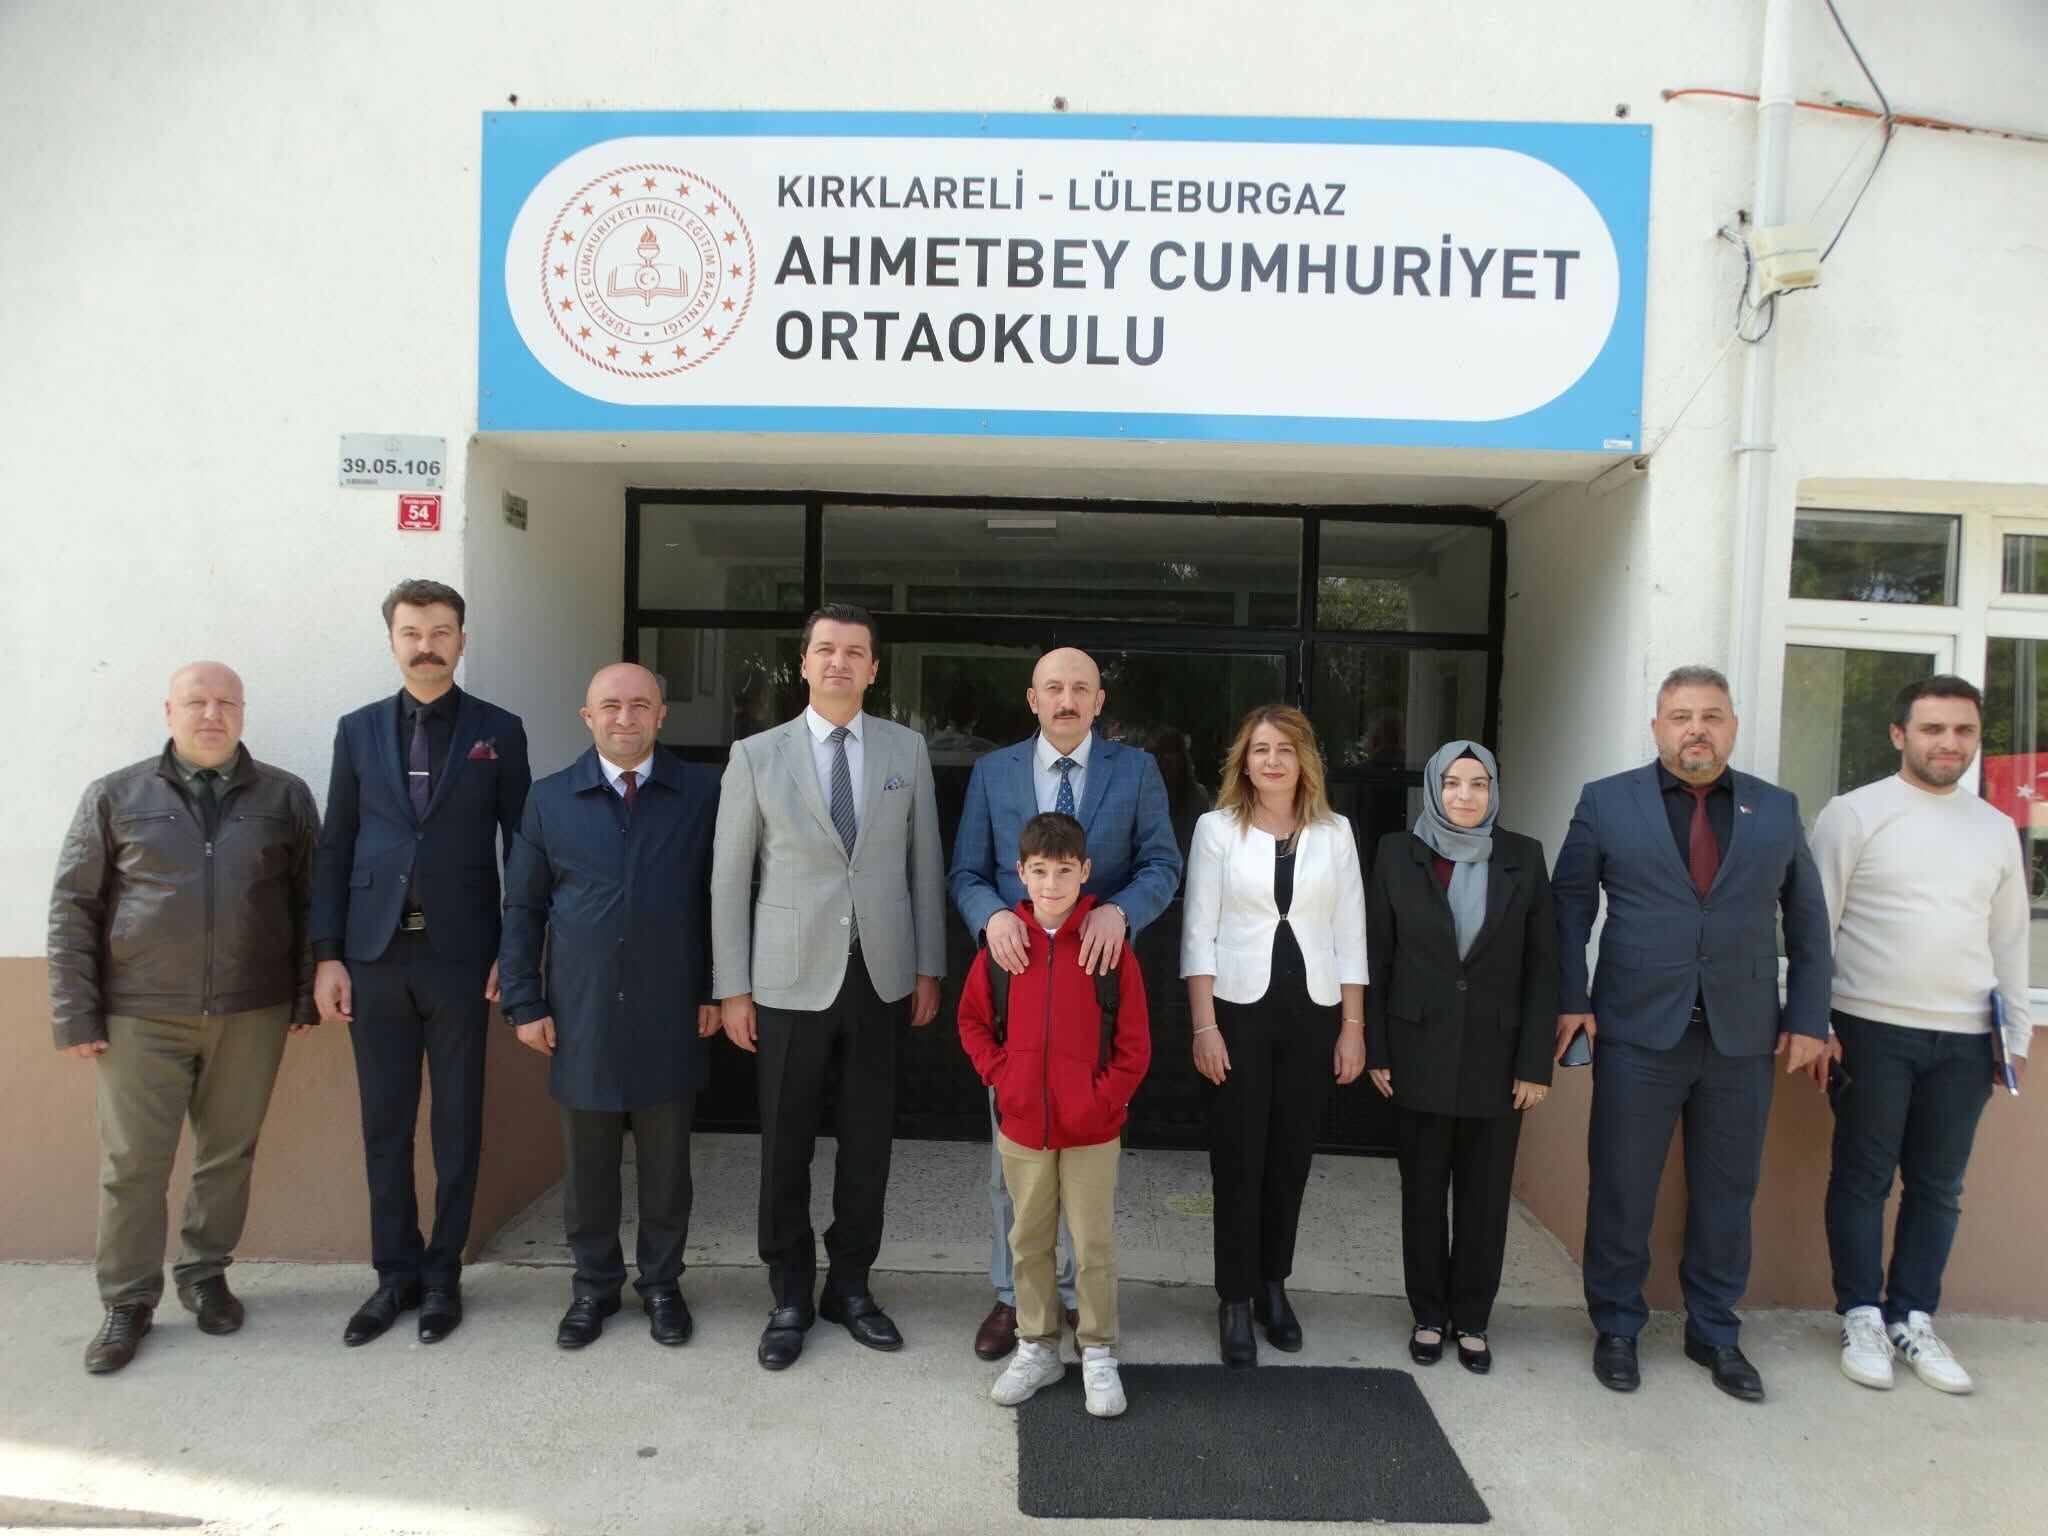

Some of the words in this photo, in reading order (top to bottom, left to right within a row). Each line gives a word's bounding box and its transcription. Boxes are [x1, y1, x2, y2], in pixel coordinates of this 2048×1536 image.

[779, 170, 1022, 209] KIRKLARELİ
[1070, 171, 1345, 215] LÜLEBURGAZ
[581, 203, 640, 286] CUMHURİYETİ
[685, 219, 716, 266] EĞİTİM
[775, 236, 1129, 289] AHMETBEY
[1149, 234, 1580, 299] CUMHURİYET
[585, 290, 632, 336] TÜRKİYE
[663, 271, 716, 336] BAKANLIĞI
[775, 311, 1164, 366] ORTAOKULU
[343, 458, 441, 475] 39.05.106
[408, 504, 429, 520] 54
